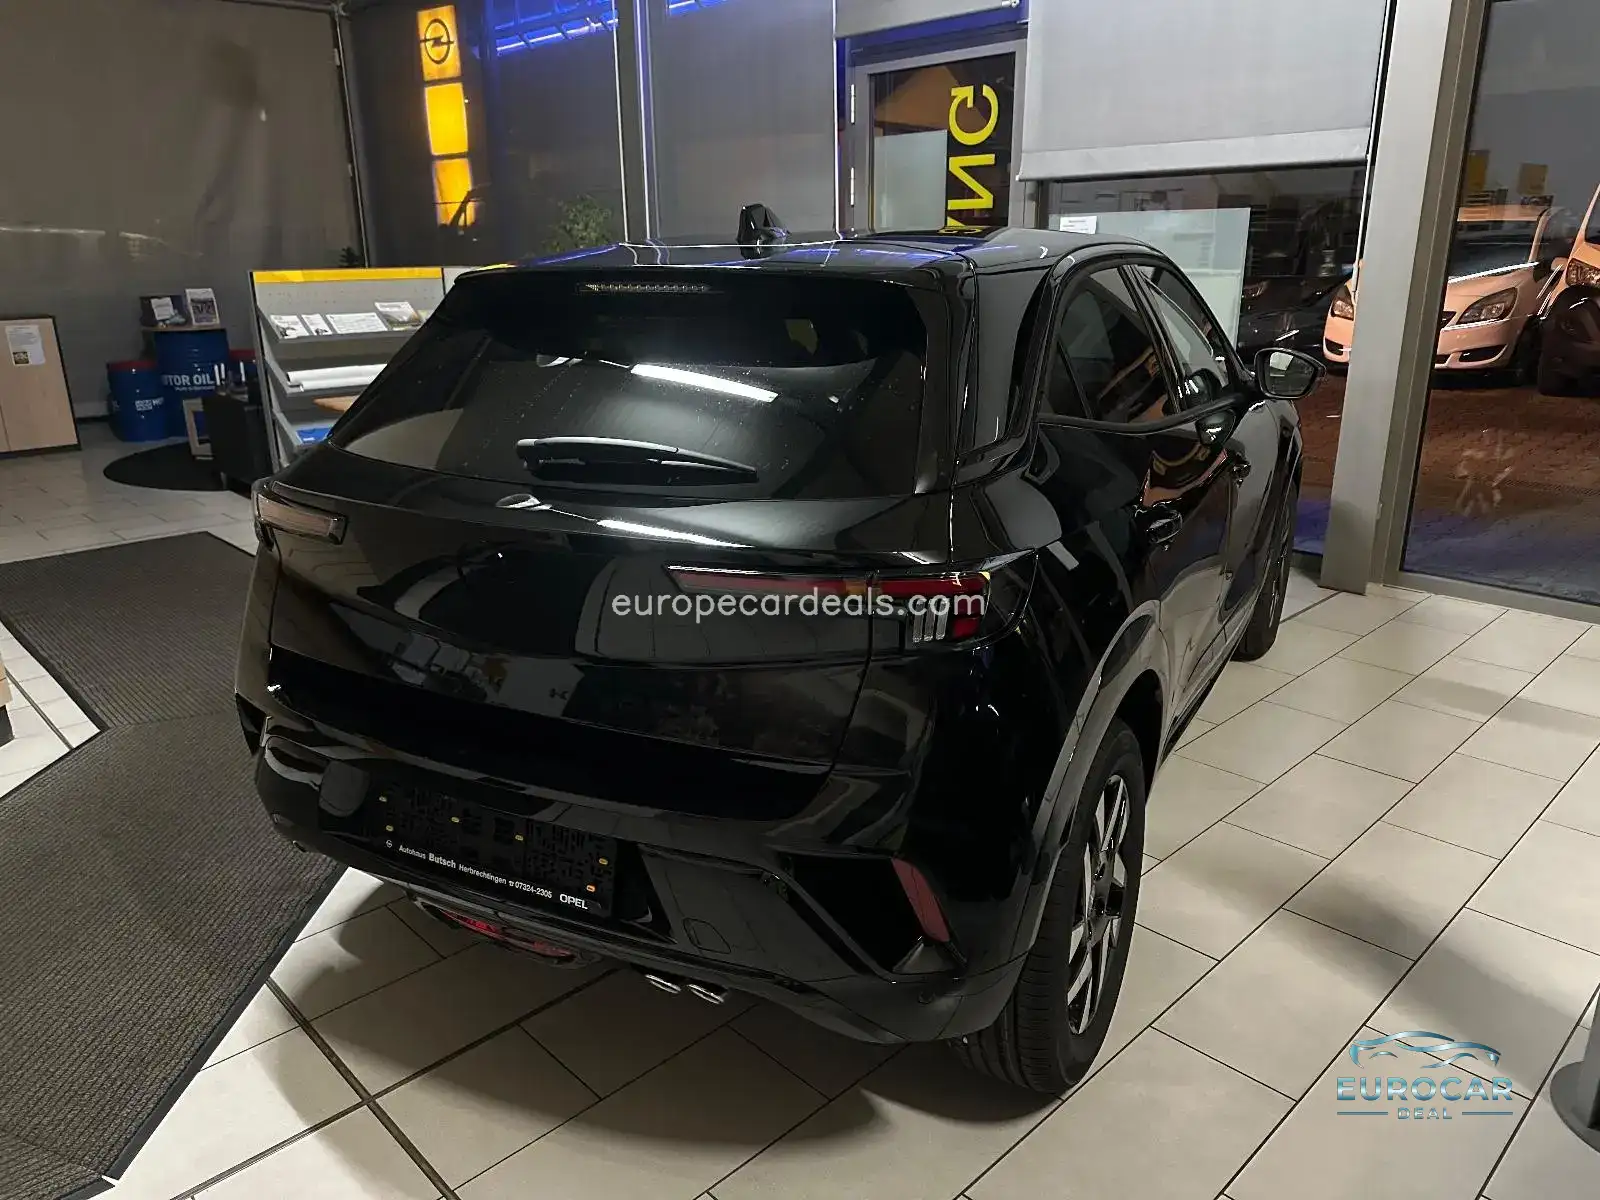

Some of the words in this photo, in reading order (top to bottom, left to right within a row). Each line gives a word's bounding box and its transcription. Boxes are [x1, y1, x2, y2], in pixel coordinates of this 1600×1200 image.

[193, 373, 216, 385] OIL
[398, 844, 427, 860] Autohaus
[428, 852, 457, 869] Butsch
[458, 863, 508, 886] Herbrechtingen
[515, 881, 553, 899] 07324-2305
[559, 893, 589, 910] OPEL
